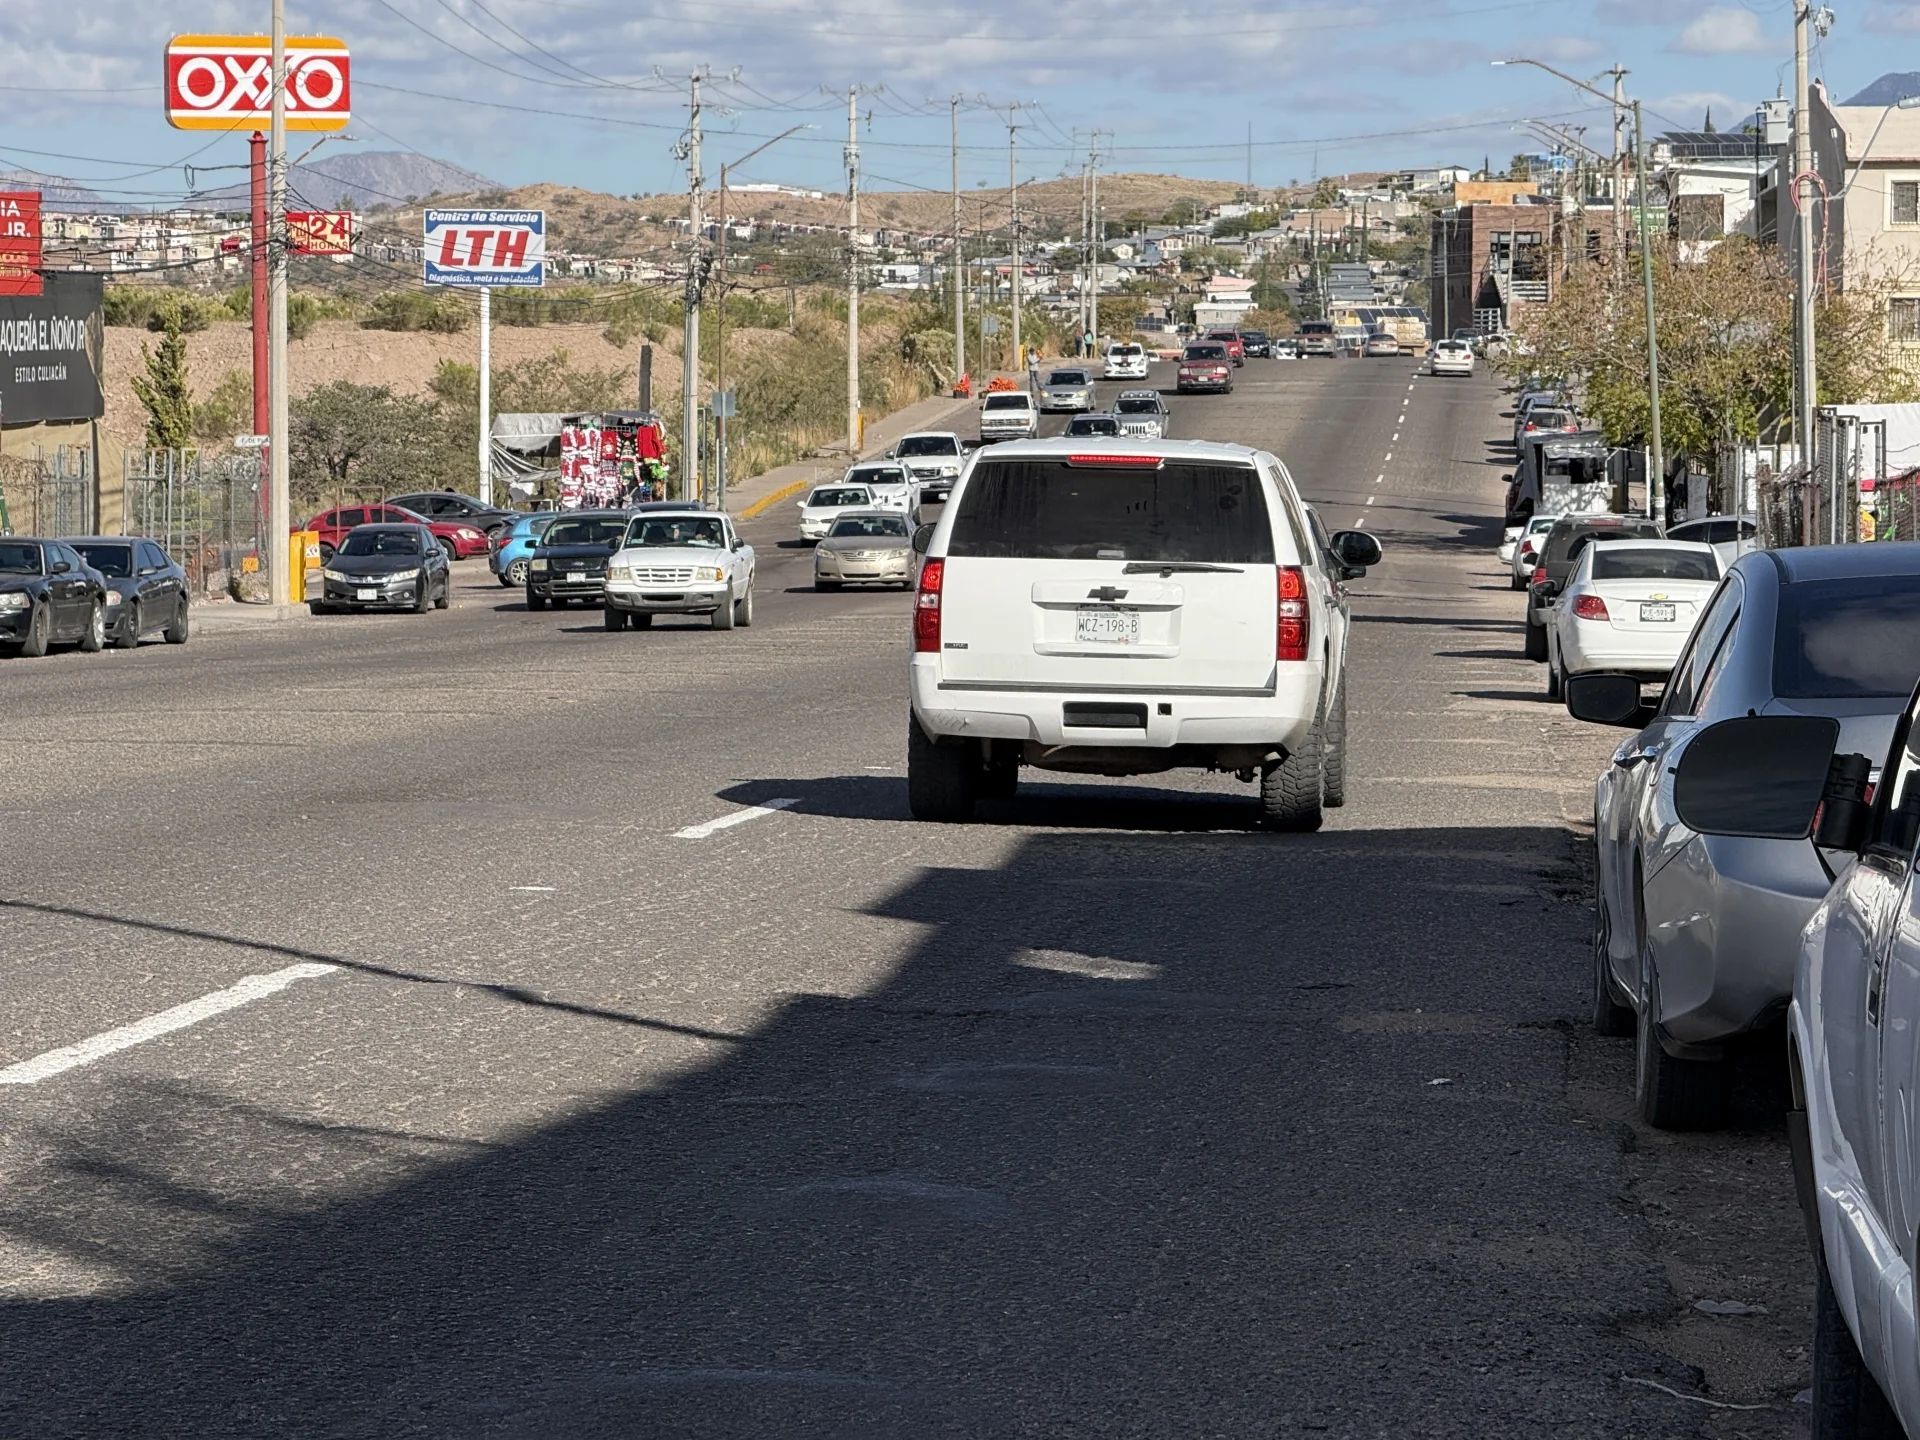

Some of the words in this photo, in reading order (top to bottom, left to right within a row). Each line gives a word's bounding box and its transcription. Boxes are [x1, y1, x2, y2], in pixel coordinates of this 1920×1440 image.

[177, 56, 343, 110] OXXO
[310, 214, 346, 240] 24
[428, 211, 469, 222] Centro
[471, 211, 487, 222] de
[488, 211, 539, 223] Servicio
[310, 241, 348, 250] HORAS
[439, 230, 530, 267] LTH
[39, 320, 49, 350] EL
[51, 315, 76, 350] ÑOÑO
[15, 366, 36, 383] ESTILO
[38, 362, 67, 381] CULIACÁN
[1079, 618, 1138, 633] WCZ-198-B
